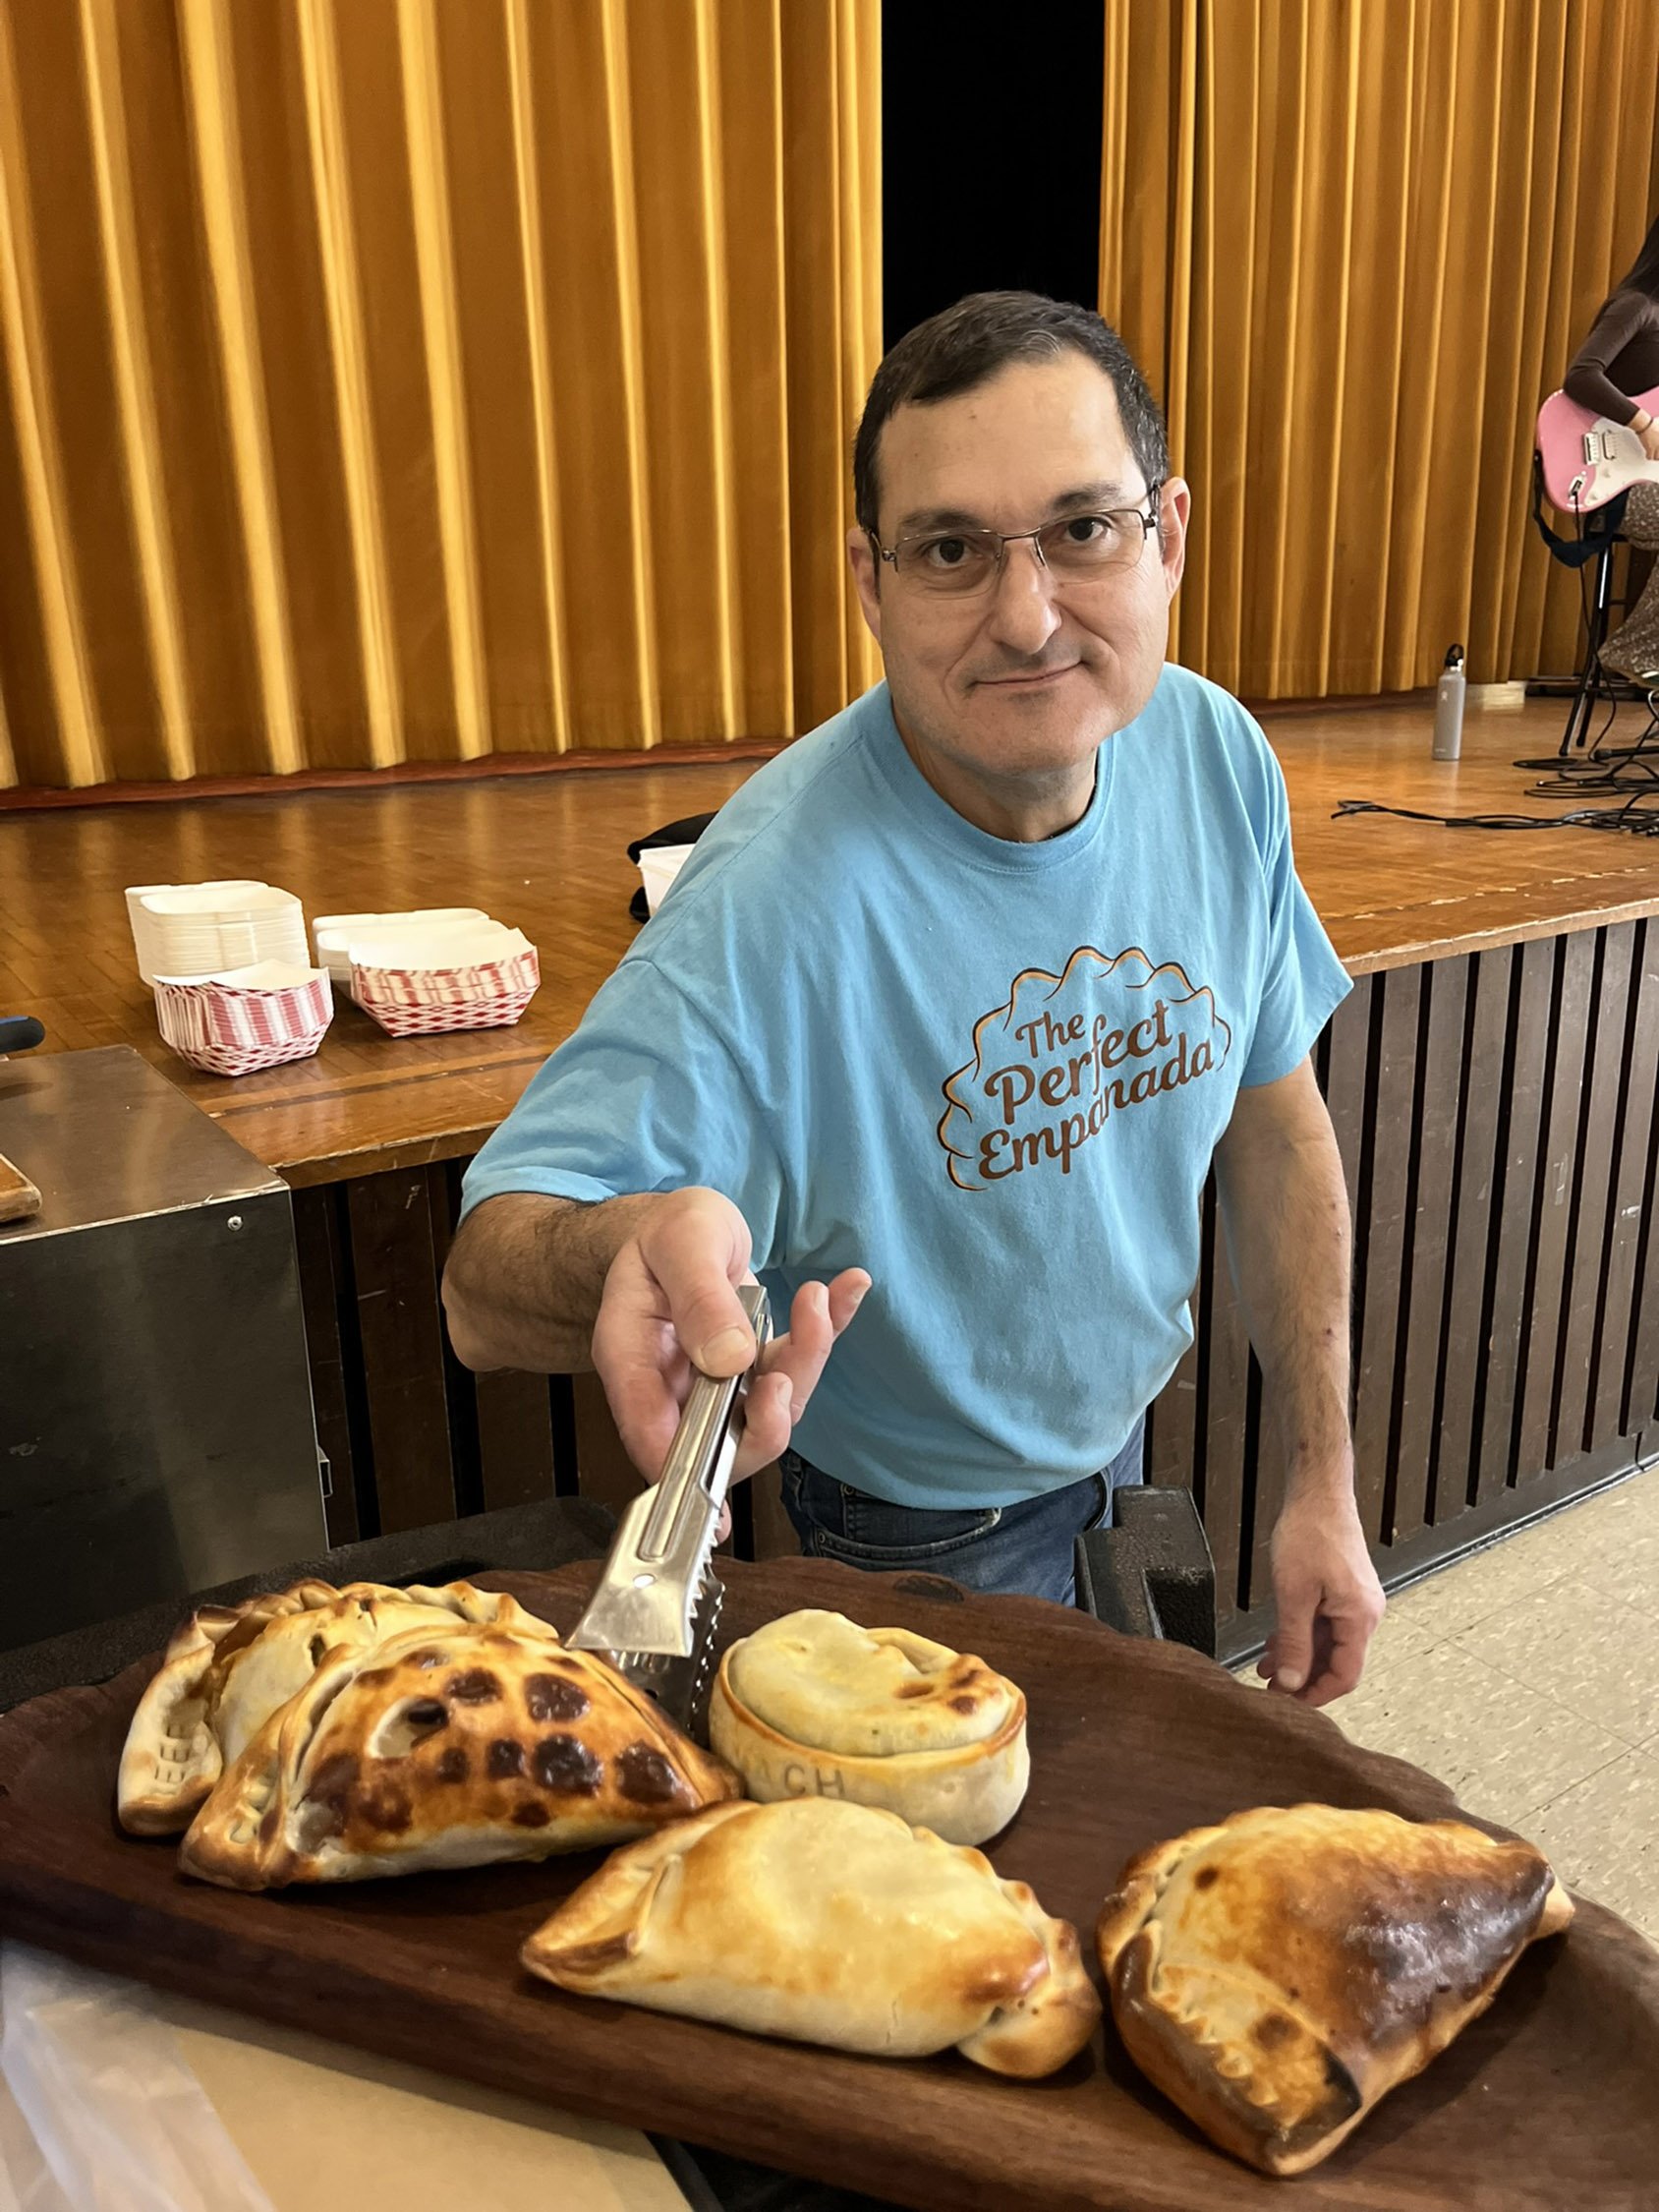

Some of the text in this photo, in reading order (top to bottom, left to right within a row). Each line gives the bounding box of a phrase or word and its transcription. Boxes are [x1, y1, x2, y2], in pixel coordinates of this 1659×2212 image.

[984, 999, 1172, 1126] Perfect
[1015, 1011, 1086, 1059] The
[979, 1032, 1214, 1180] Empanada
[784, 1764, 845, 1796] CH
